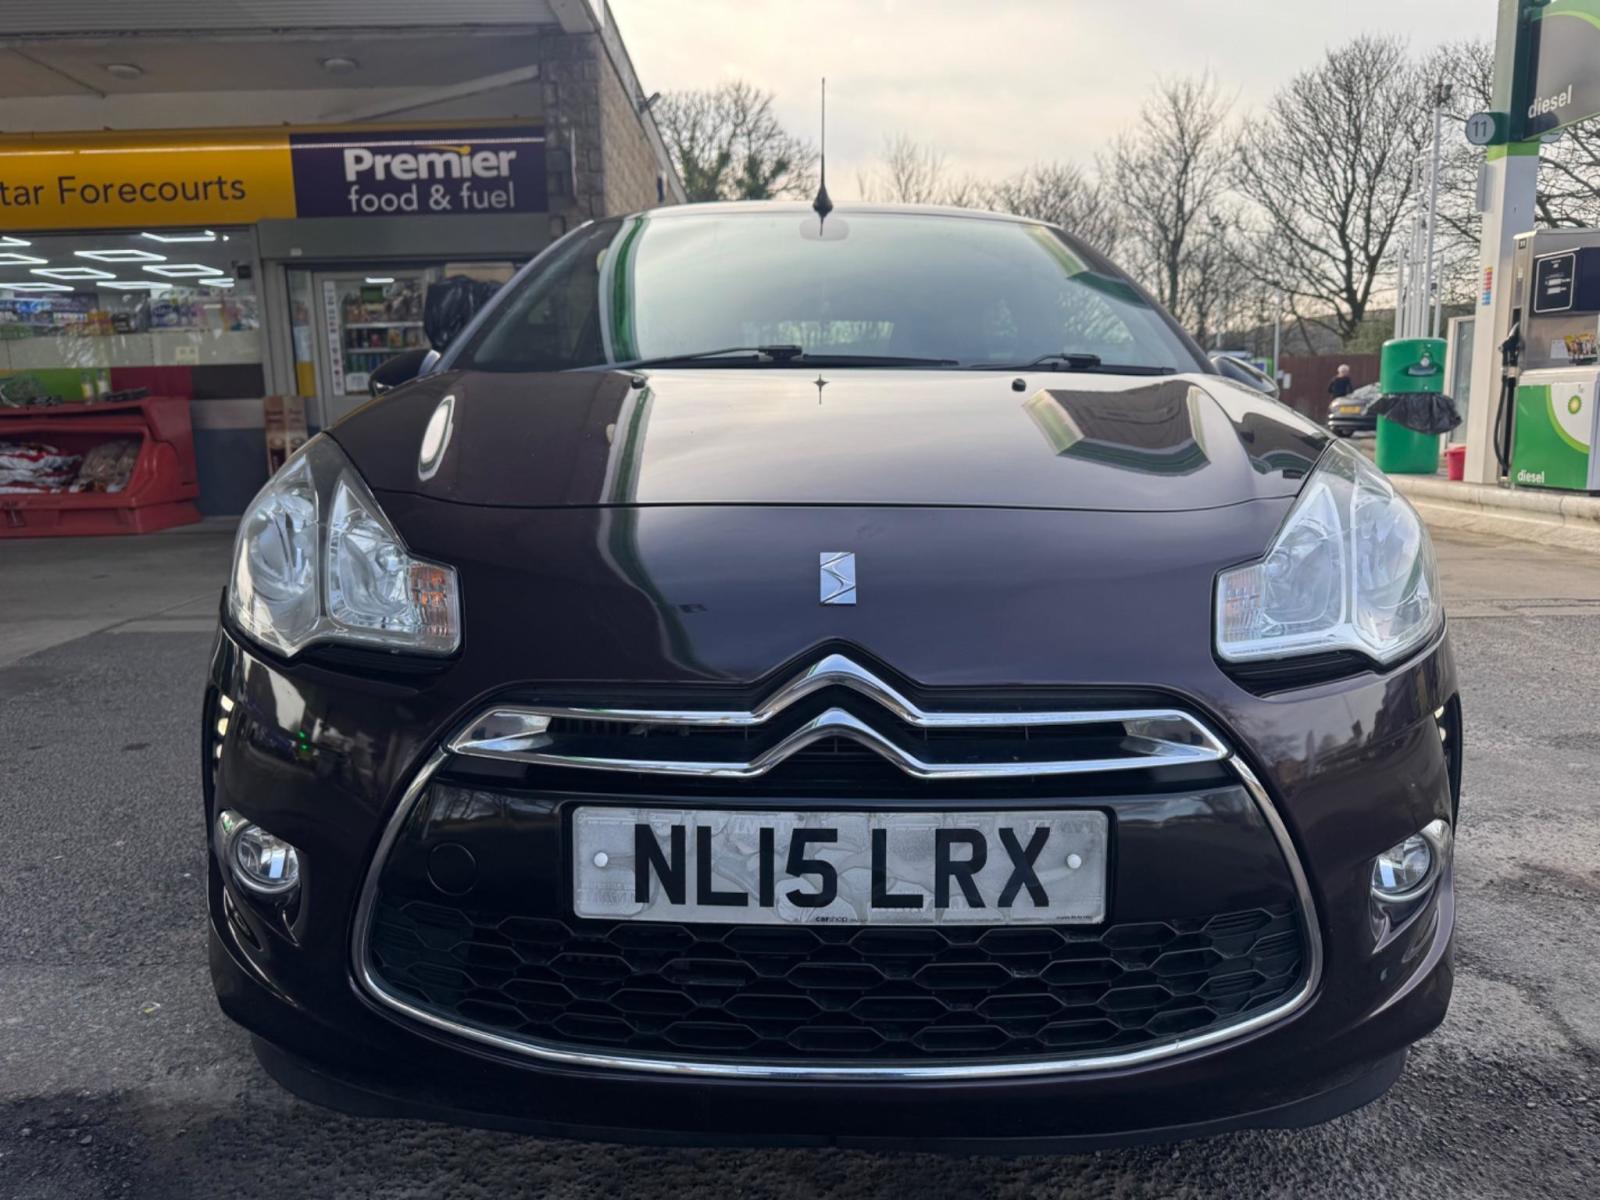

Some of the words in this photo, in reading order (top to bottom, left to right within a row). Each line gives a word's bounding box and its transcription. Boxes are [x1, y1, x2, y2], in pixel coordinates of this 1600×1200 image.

[1527, 84, 1573, 119] diesel
[1471, 120, 1487, 137] 11
[343, 145, 517, 182] Premier
[57, 175, 246, 205] Forecourts
[348, 184, 419, 213] food
[429, 184, 452, 211] &
[460, 181, 516, 209] fuel
[1517, 469, 1545, 483] diesel
[634, 823, 838, 908] NL15
[871, 826, 1051, 909] LRX
